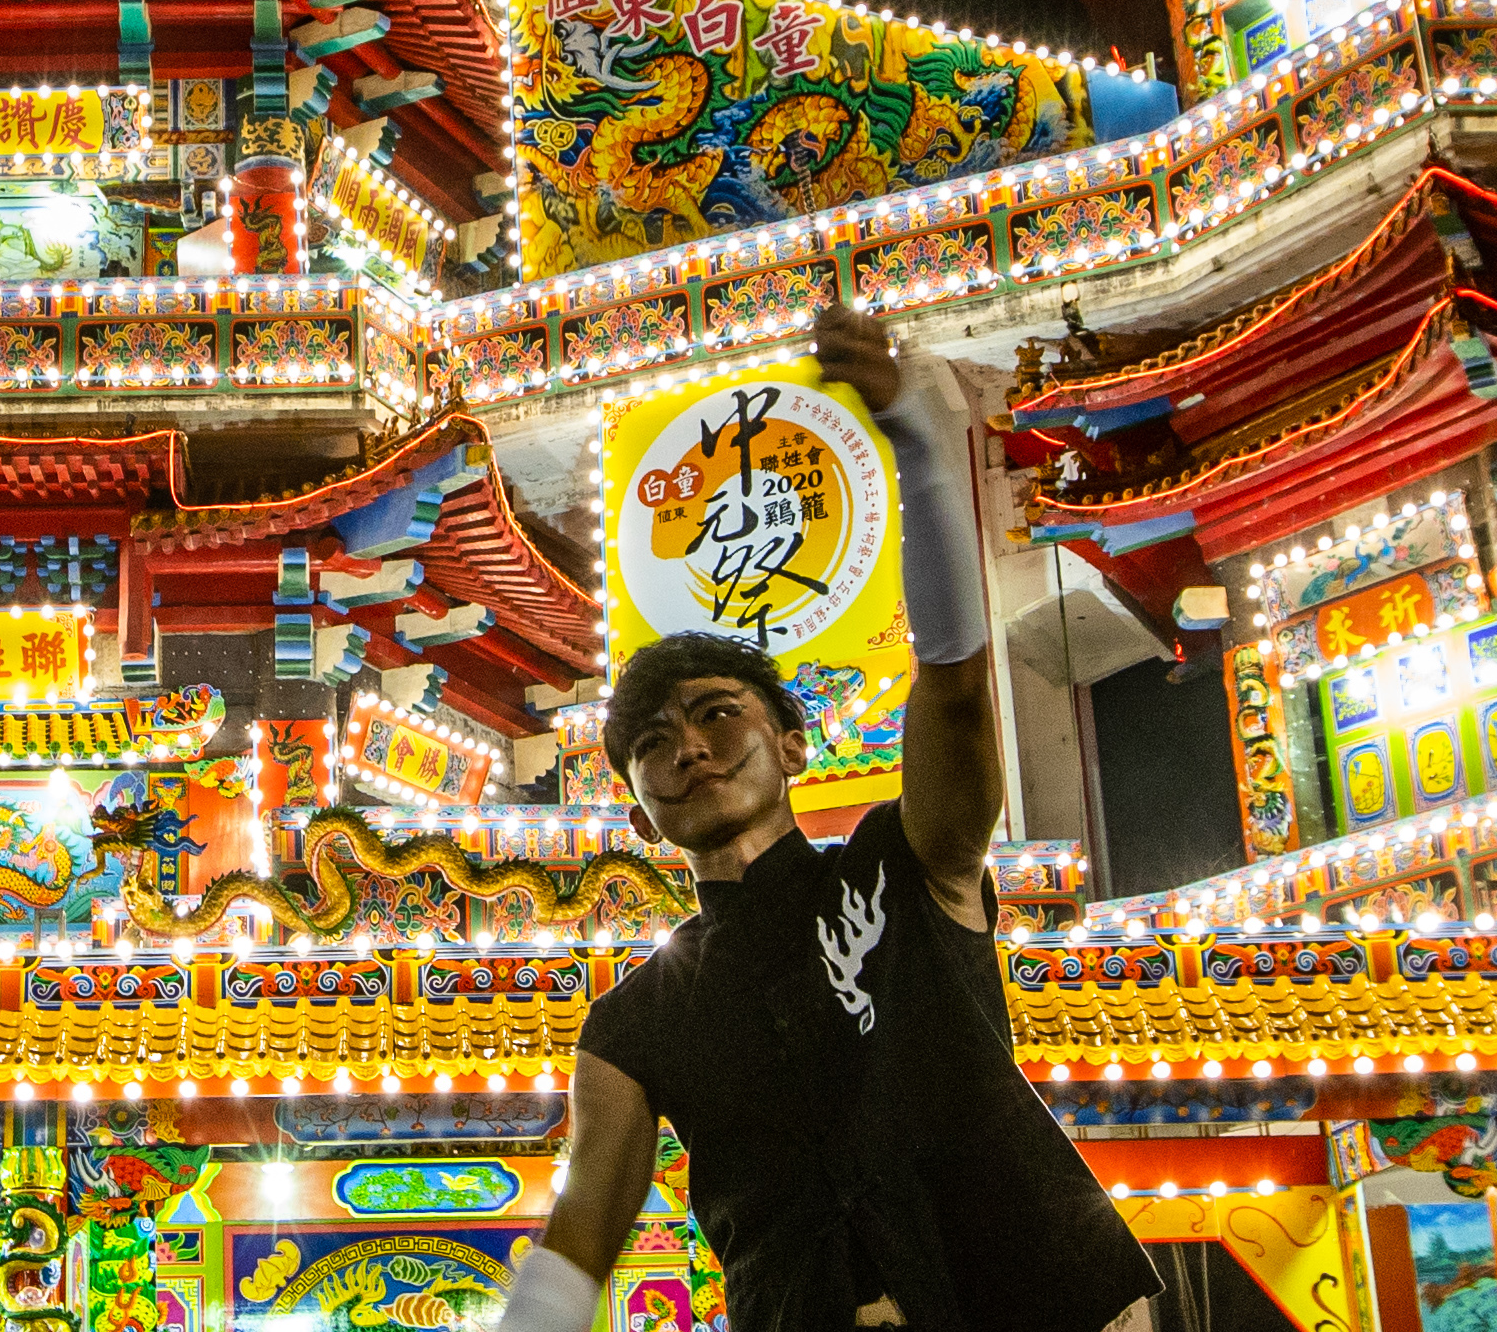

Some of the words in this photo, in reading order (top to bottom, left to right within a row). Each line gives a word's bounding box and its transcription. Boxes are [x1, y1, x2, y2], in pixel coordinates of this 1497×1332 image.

[333, 167, 423, 273] 風調雨順
[759, 445, 826, 473] 聯姓會
[777, 432, 809, 450] 主普
[643, 465, 700, 502] 白童
[763, 469, 824, 497] 2020
[1324, 584, 1422, 656] 祈求
[391, 734, 441, 784] 勝會
